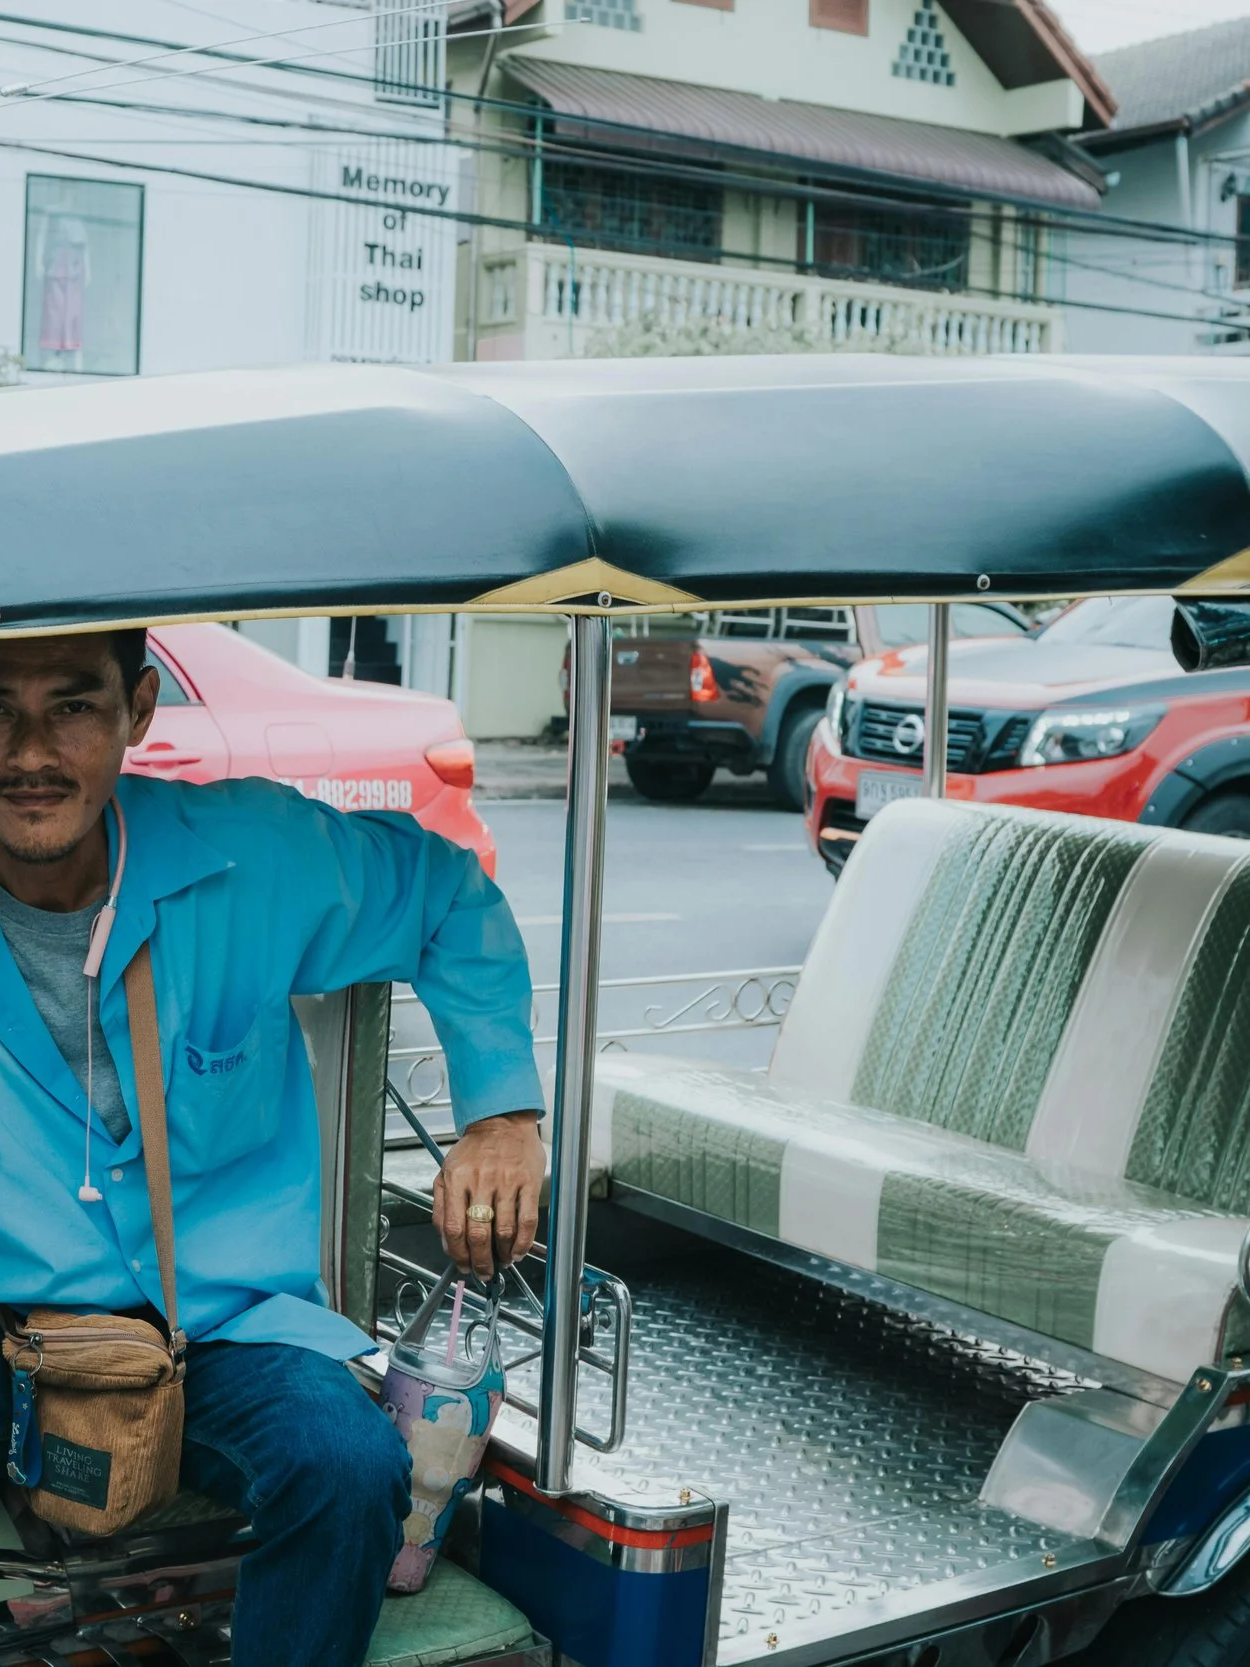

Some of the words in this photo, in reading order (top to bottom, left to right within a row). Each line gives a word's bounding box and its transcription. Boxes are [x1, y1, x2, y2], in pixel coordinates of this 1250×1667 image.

[341, 165, 450, 205] Memory
[383, 210, 407, 231] of
[364, 242, 423, 270] Thai
[359, 281, 425, 312] shop
[46, 1450, 102, 1477] TRAVELING
[56, 1445, 93, 1465] LIVING
[54, 1464, 90, 1482] SHARE
